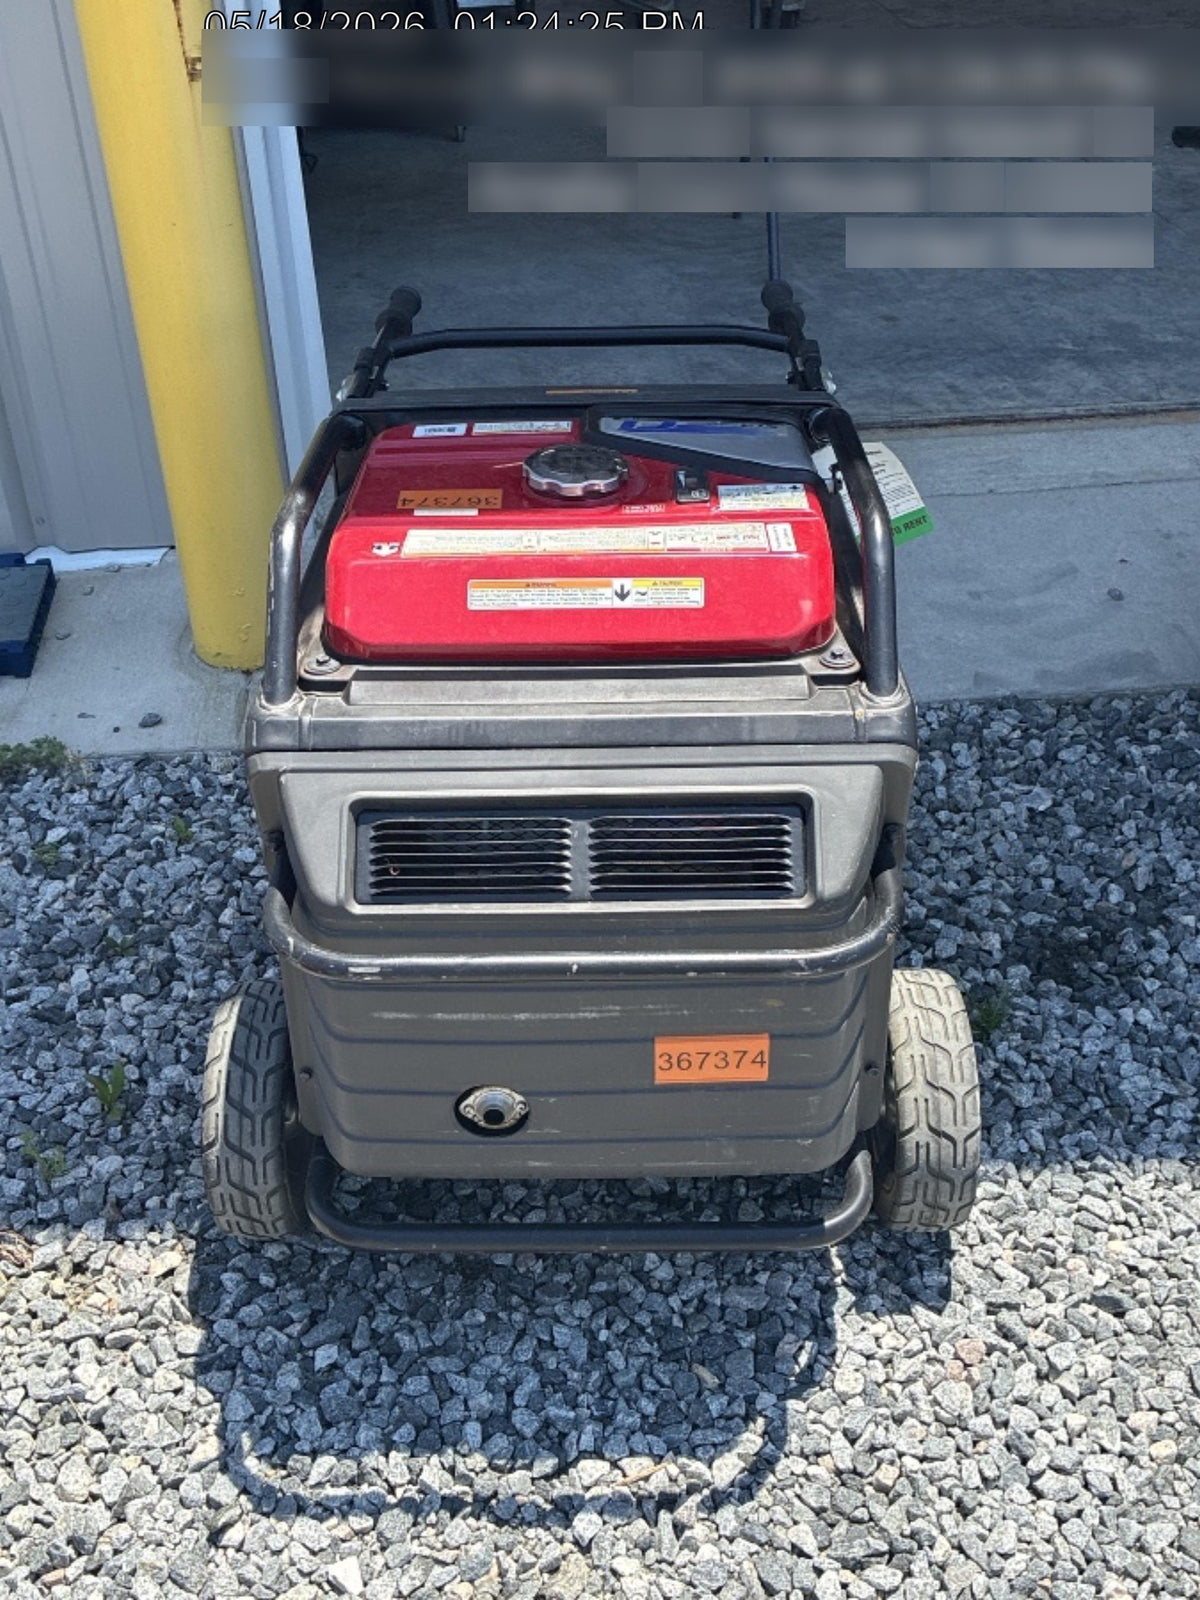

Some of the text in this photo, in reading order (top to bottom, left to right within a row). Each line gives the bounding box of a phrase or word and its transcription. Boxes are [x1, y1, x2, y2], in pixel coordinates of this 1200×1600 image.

[401, 496, 499, 508] 367374
[904, 515, 928, 532] RENT
[658, 1049, 767, 1071] 367374
